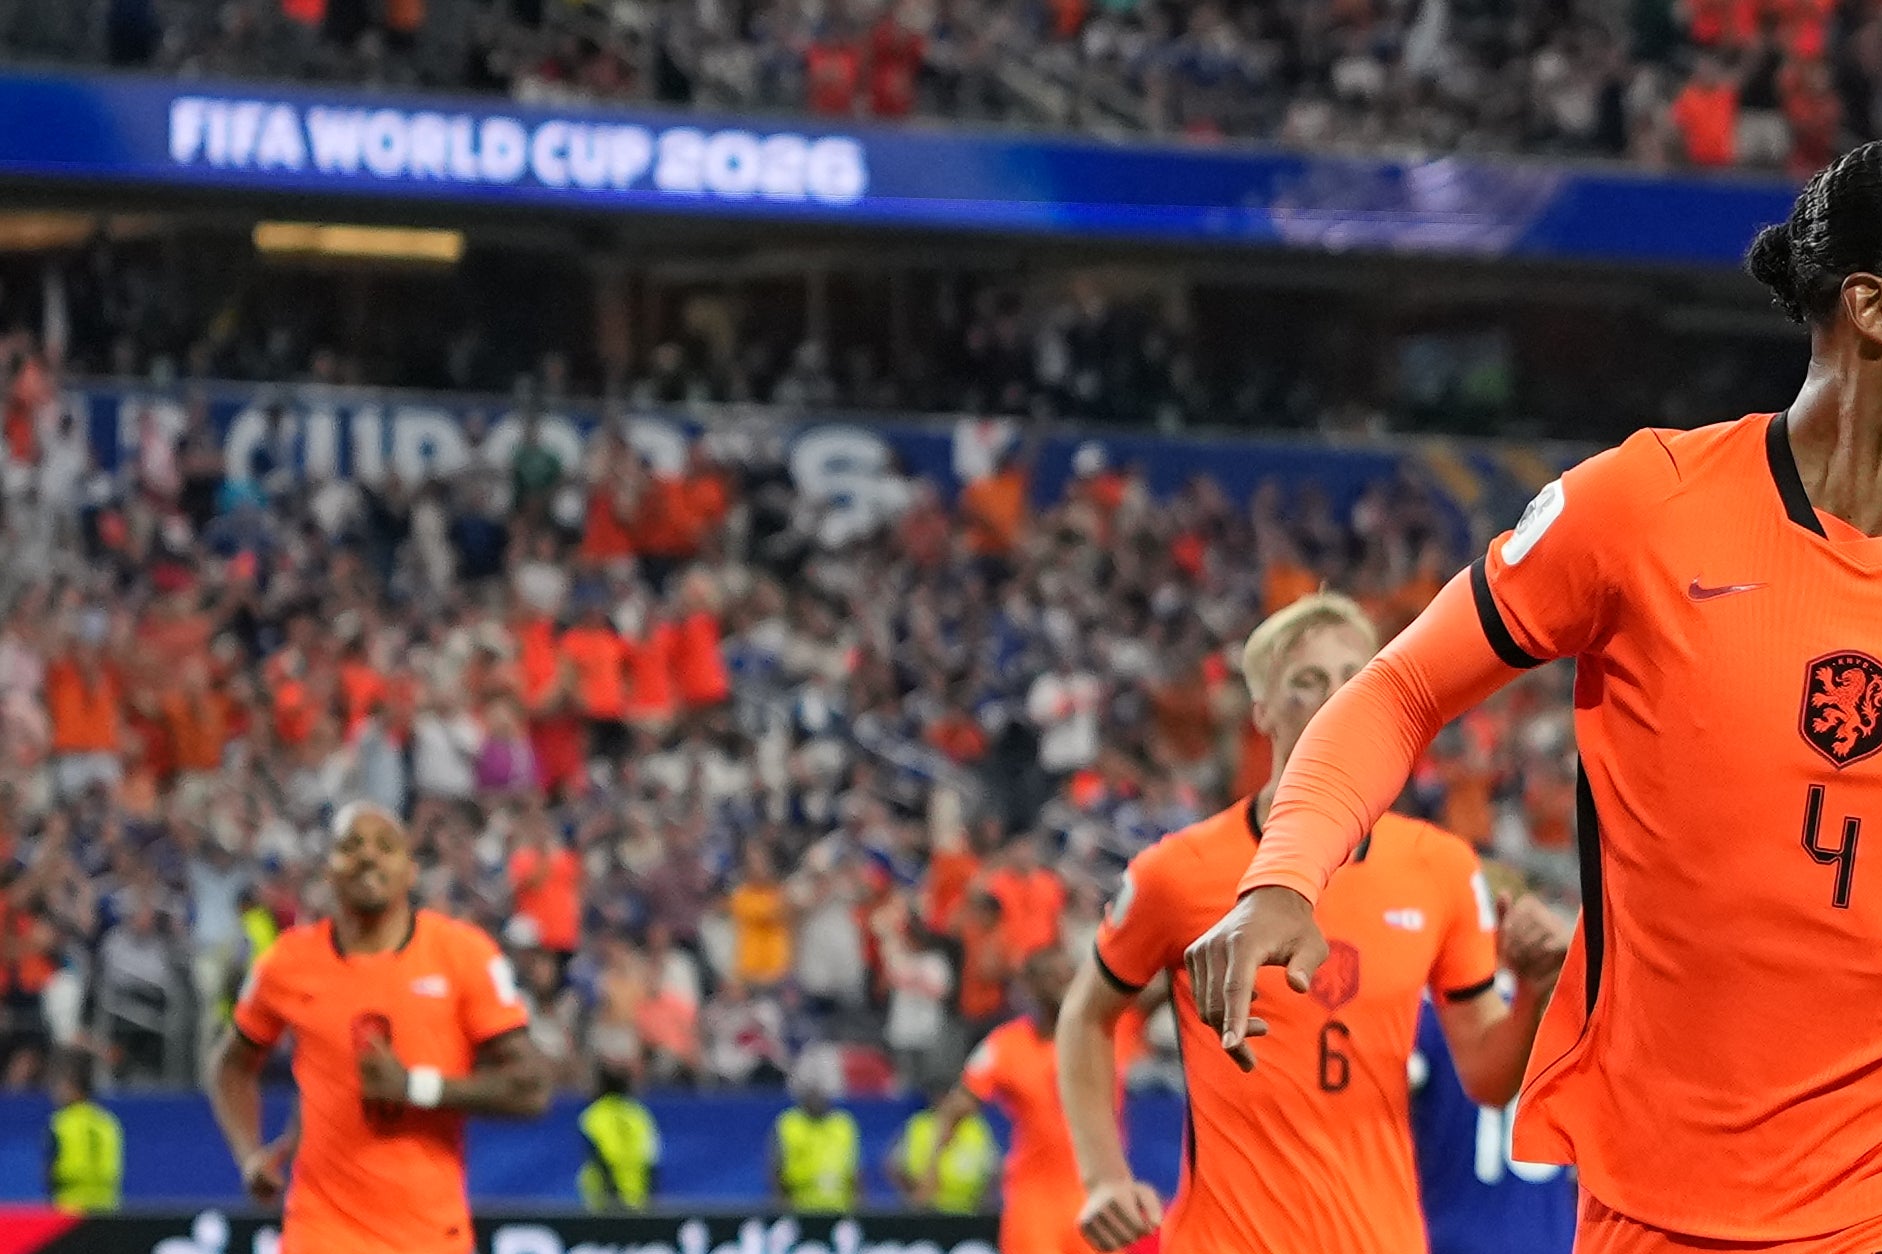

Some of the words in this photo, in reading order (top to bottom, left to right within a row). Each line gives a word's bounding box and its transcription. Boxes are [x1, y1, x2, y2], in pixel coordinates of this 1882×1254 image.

[169, 97, 302, 170] FIFA
[306, 107, 527, 184] WORLD
[532, 118, 653, 190] CUP
[651, 127, 868, 205] 2026
[1801, 784, 1861, 909] 4
[1319, 1020, 1350, 1093] 6
